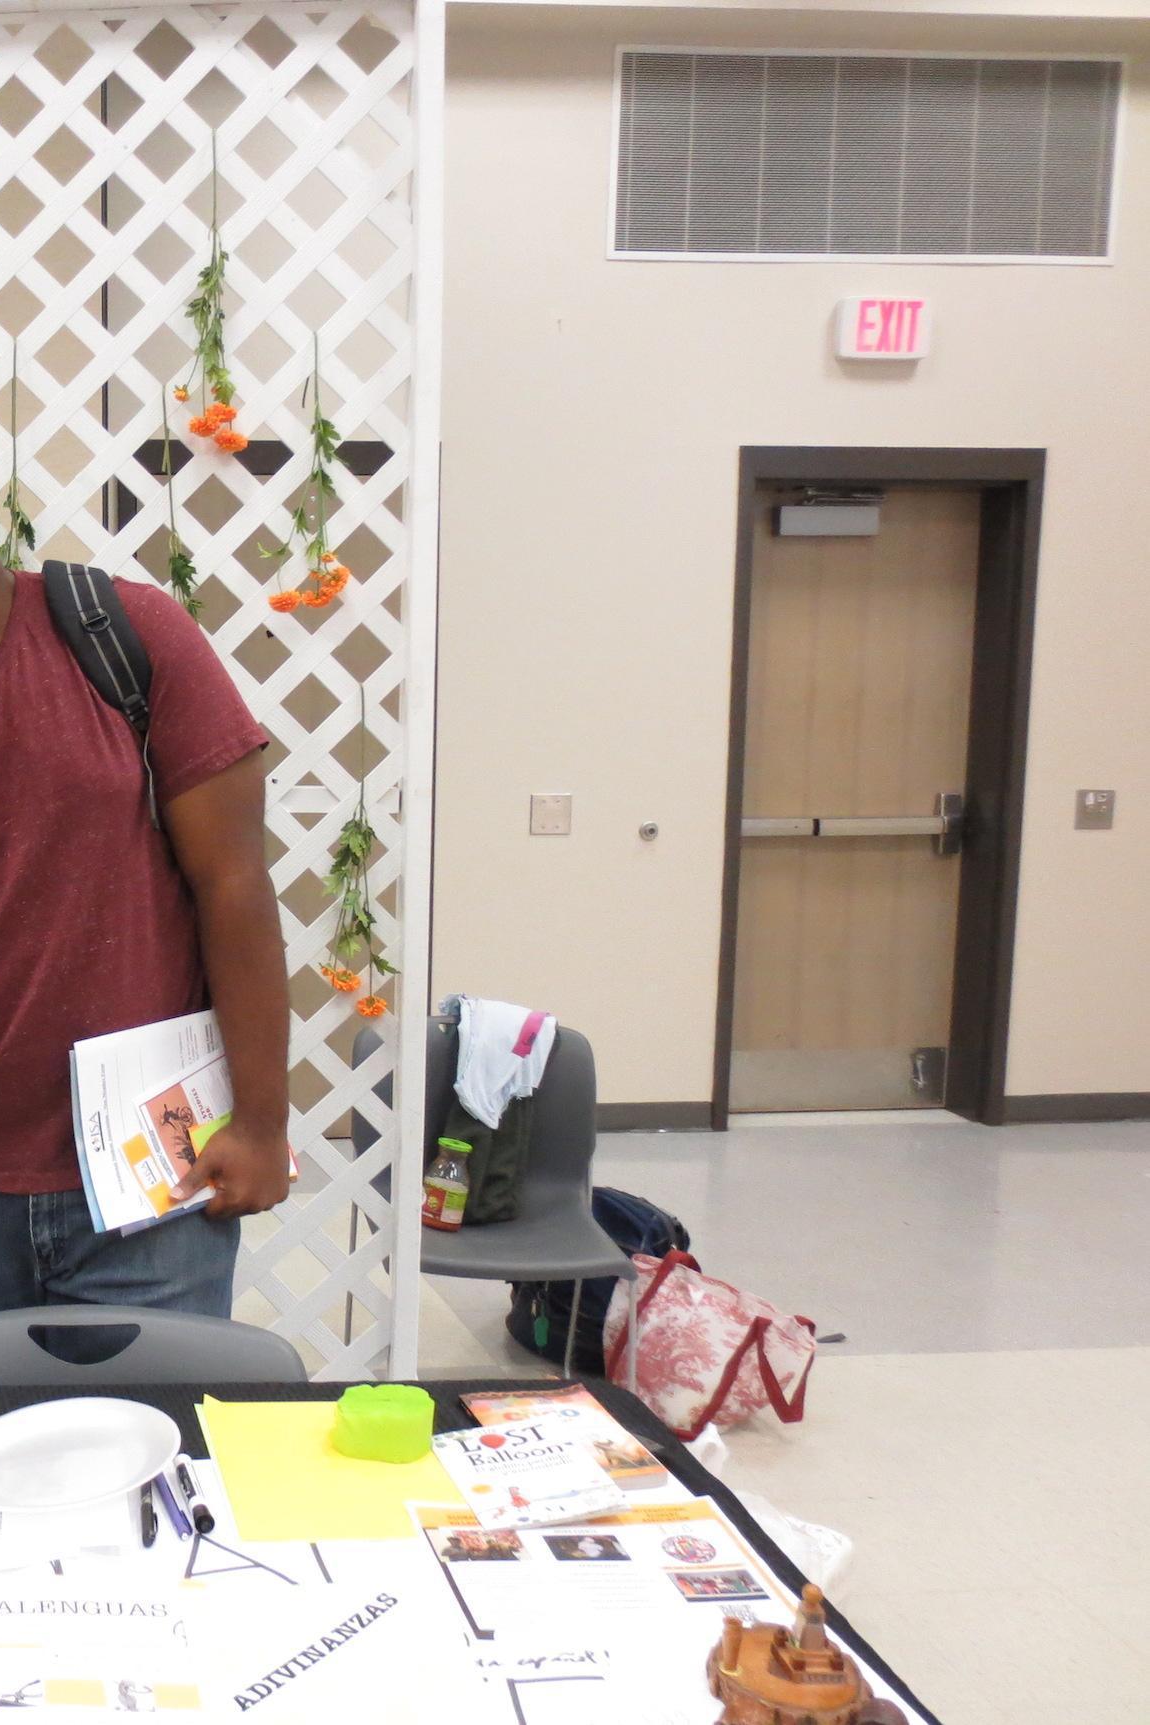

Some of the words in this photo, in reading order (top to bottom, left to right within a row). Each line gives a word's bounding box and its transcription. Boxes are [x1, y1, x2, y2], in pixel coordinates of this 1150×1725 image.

[855, 300, 924, 352] EXIT
[466, 1441, 564, 1468] Balloon
[233, 1592, 400, 1712] ADIVINANZAS
